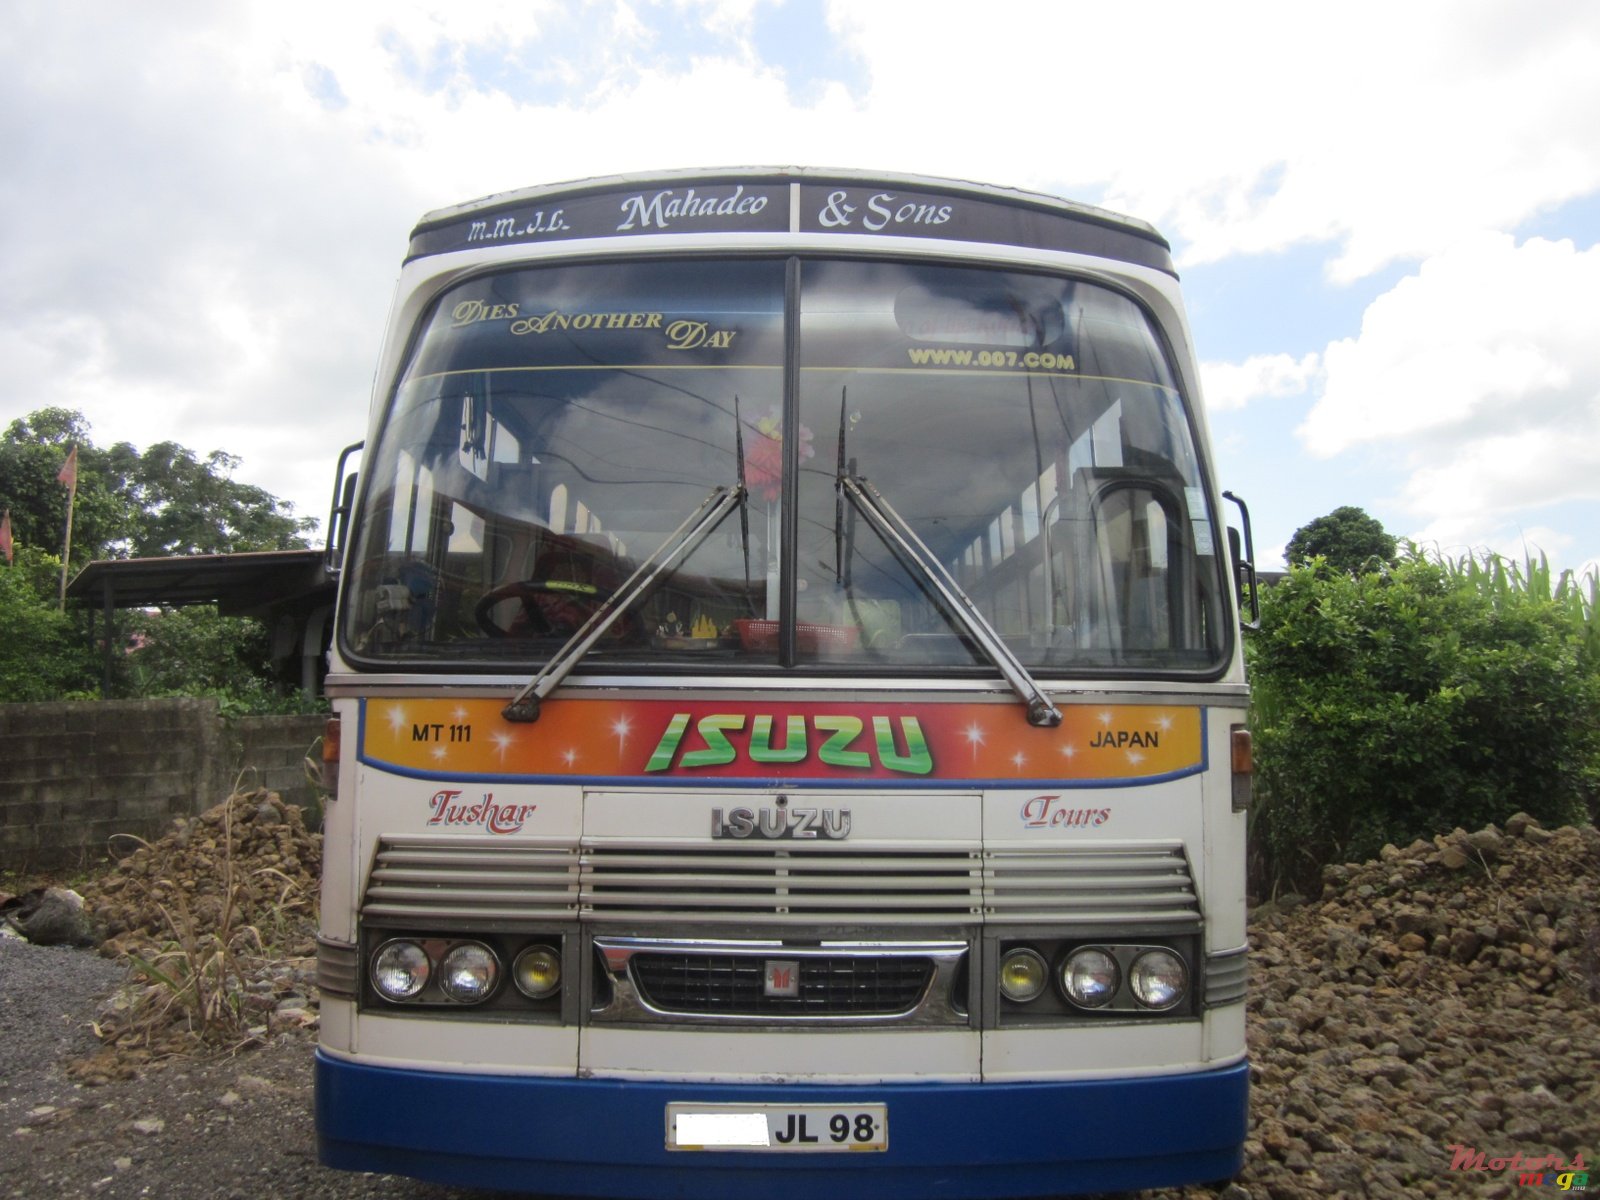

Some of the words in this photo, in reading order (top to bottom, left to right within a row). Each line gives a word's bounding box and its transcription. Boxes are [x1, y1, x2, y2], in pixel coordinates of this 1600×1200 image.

[616, 185, 768, 231] Mahadeo
[818, 190, 857, 228] &
[862, 192, 953, 231] Sons
[510, 309, 662, 335] ANOTHER
[665, 319, 737, 350] DAY
[908, 348, 1075, 370] WWW.007.COM
[412, 724, 445, 742] MT
[449, 724, 471, 742] 111
[644, 713, 933, 775] ISUZU
[1089, 731, 1159, 748] JAPAN
[426, 790, 537, 835] Tushar
[711, 807, 851, 840] ISUZU
[1020, 795, 1112, 829] Tours
[775, 1114, 819, 1143] JL
[829, 1113, 875, 1142] 98
